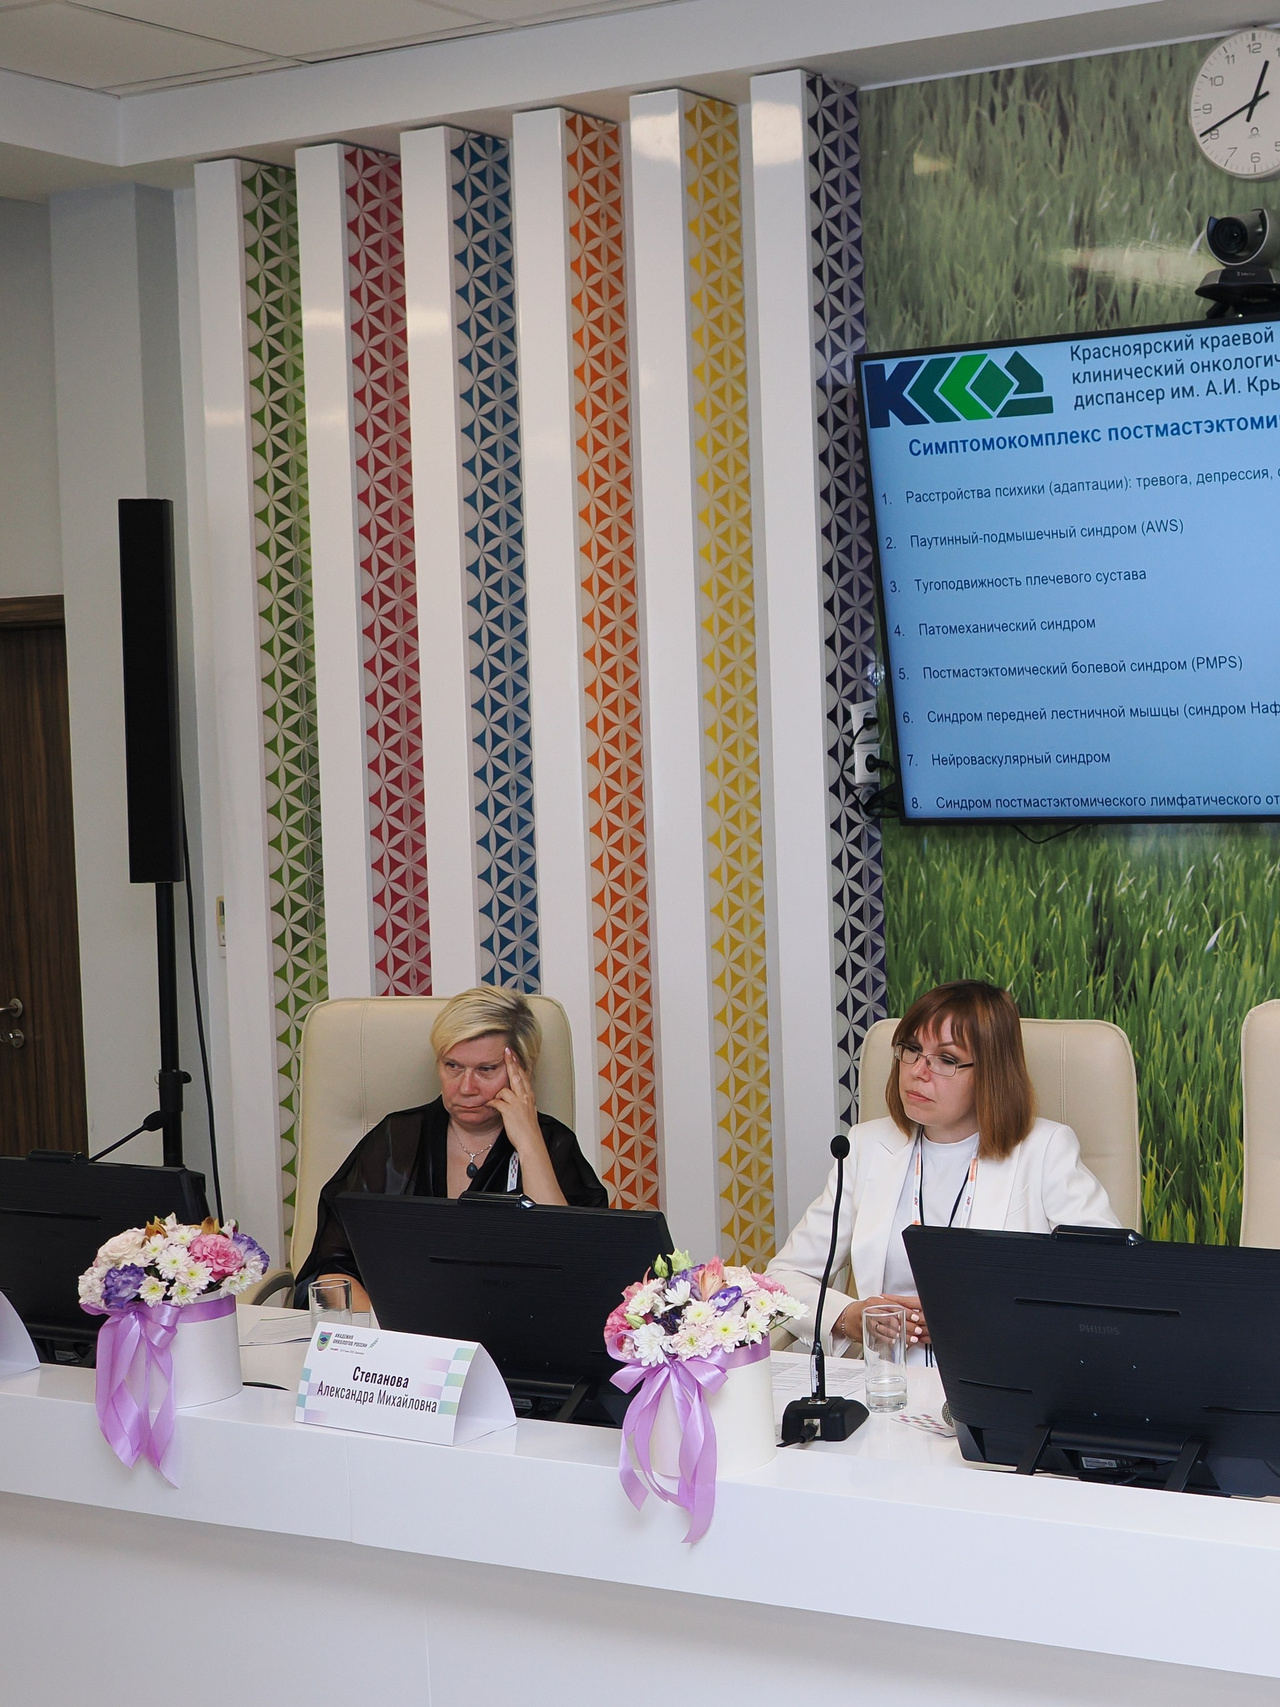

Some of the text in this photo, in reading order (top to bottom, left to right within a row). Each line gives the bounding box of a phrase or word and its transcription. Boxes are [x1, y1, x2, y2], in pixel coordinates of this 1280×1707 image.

[1246, 43, 1262, 54] 12
[1276, 47, 1280, 57] 1
[1225, 55, 1235, 65] 11
[1209, 75, 1224, 87] 10
[1202, 103, 1212, 114] 9
[1209, 129, 1219, 140] 8
[1228, 147, 1238, 157] 7
[1251, 152, 1261, 163] 6
[1070, 326, 1274, 362] Красноярский краевой
[1072, 358, 1184, 384] клинический
[1074, 388, 1165, 411] диспансер
[1171, 385, 1199, 399] им.
[1206, 378, 1241, 396] А.И.
[909, 429, 1101, 456] Симптомокомплекс
[882, 493, 892, 505] 1.
[906, 488, 991, 504] Расстройства
[995, 485, 1045, 497] психики
[1049, 476, 1131, 496] (адаптации):
[1136, 474, 1192, 490] тревога,
[1196, 469, 1273, 485] депрессия,
[886, 519, 1183, 550] 2. Паутинный-подмышечный синдром (AWS)
[890, 570, 1146, 594] 3. Тугоподвижность плечевого сустава
[894, 618, 1096, 636] 4. Патомеханический синдром
[899, 655, 1242, 680] 5. Постмастэктомический болевой синдром (PMPS)
[903, 711, 913, 723] 6.
[927, 711, 983, 725] Синдром
[987, 708, 1047, 724] передней
[1051, 705, 1125, 719] лестничной
[1130, 707, 1179, 718] мышцы
[1184, 704, 1246, 719] (синдром
[907, 751, 1110, 768] 7. Нейроваскулярный синдром
[912, 796, 922, 808] 8.
[936, 797, 991, 811] Синдром
[996, 797, 1146, 808] постмастэктомического
[1151, 794, 1261, 808] лимфатического
[1079, 1323, 1120, 1336] PHILIPS
[352, 1366, 409, 1389] Степанова
[316, 1381, 438, 1413] Александра Михайловна
